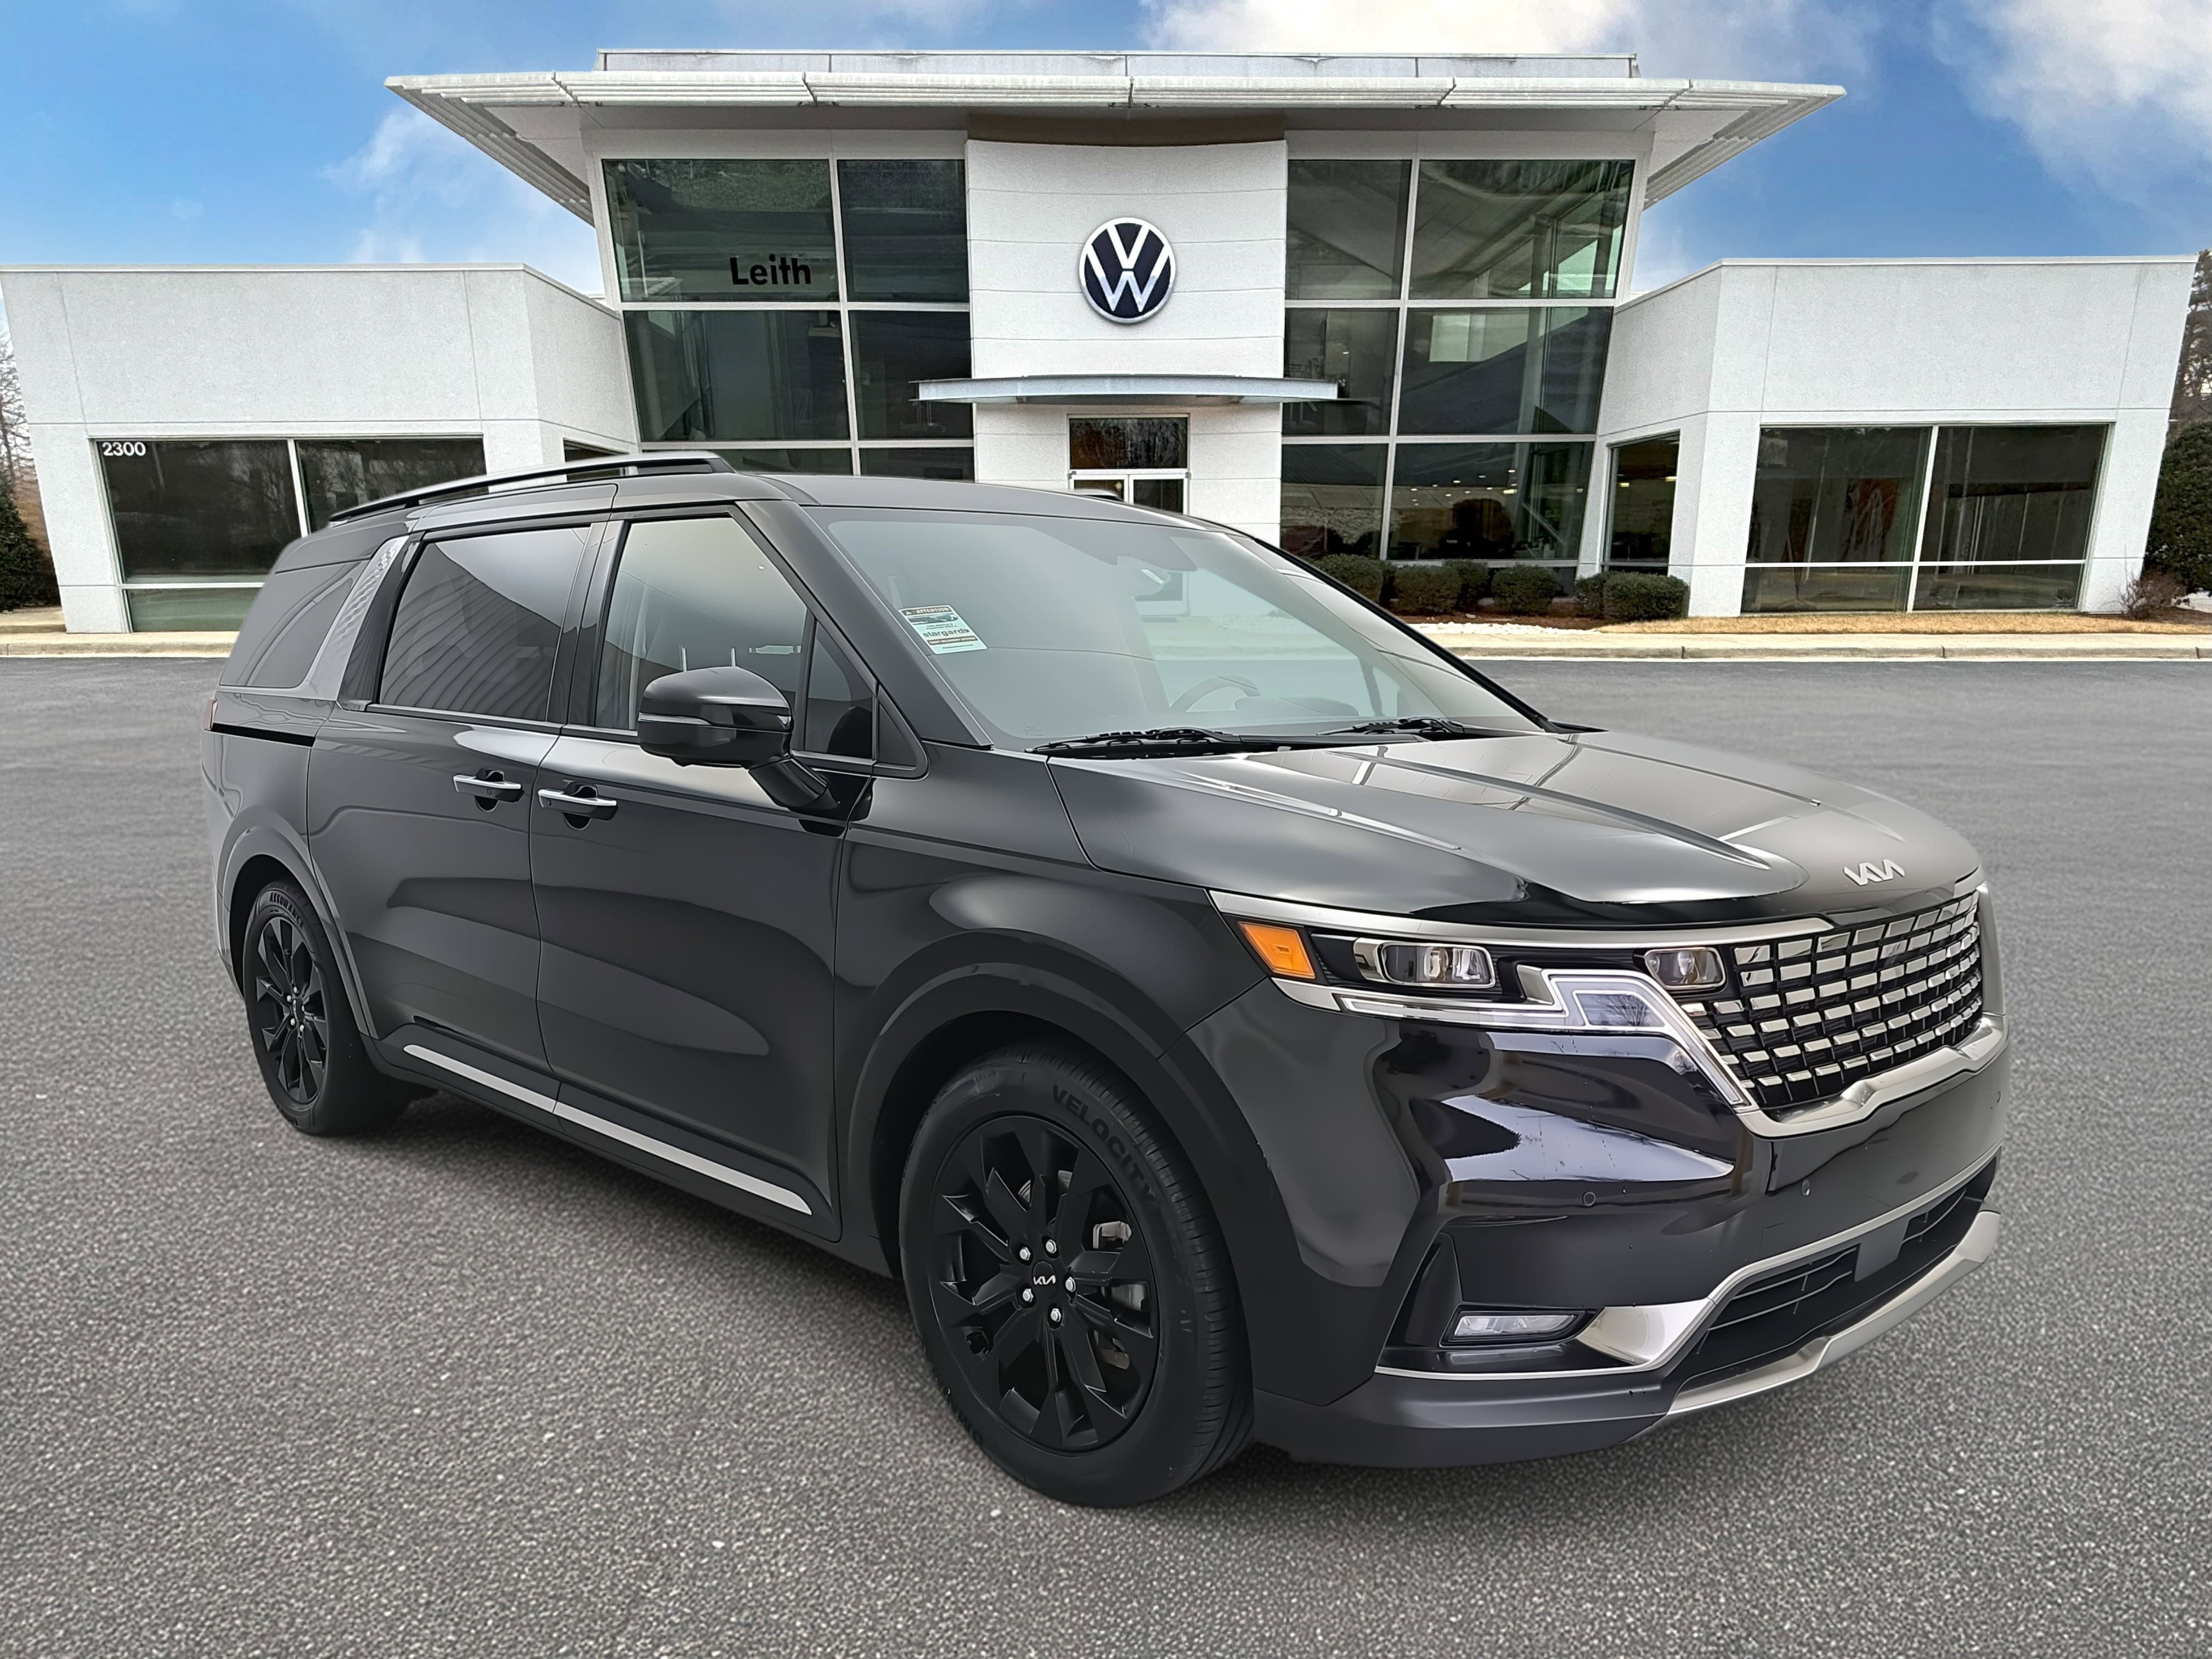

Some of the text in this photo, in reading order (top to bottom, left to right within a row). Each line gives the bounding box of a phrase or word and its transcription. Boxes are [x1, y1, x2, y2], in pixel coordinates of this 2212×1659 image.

[730, 253, 811, 286] Leith
[1086, 221, 1170, 314] VW
[102, 441, 146, 457] 2300
[1843, 859, 1905, 886] KIA
[1052, 1084, 1158, 1200] VELOCITY
[1033, 1274, 1057, 1286] KIA
